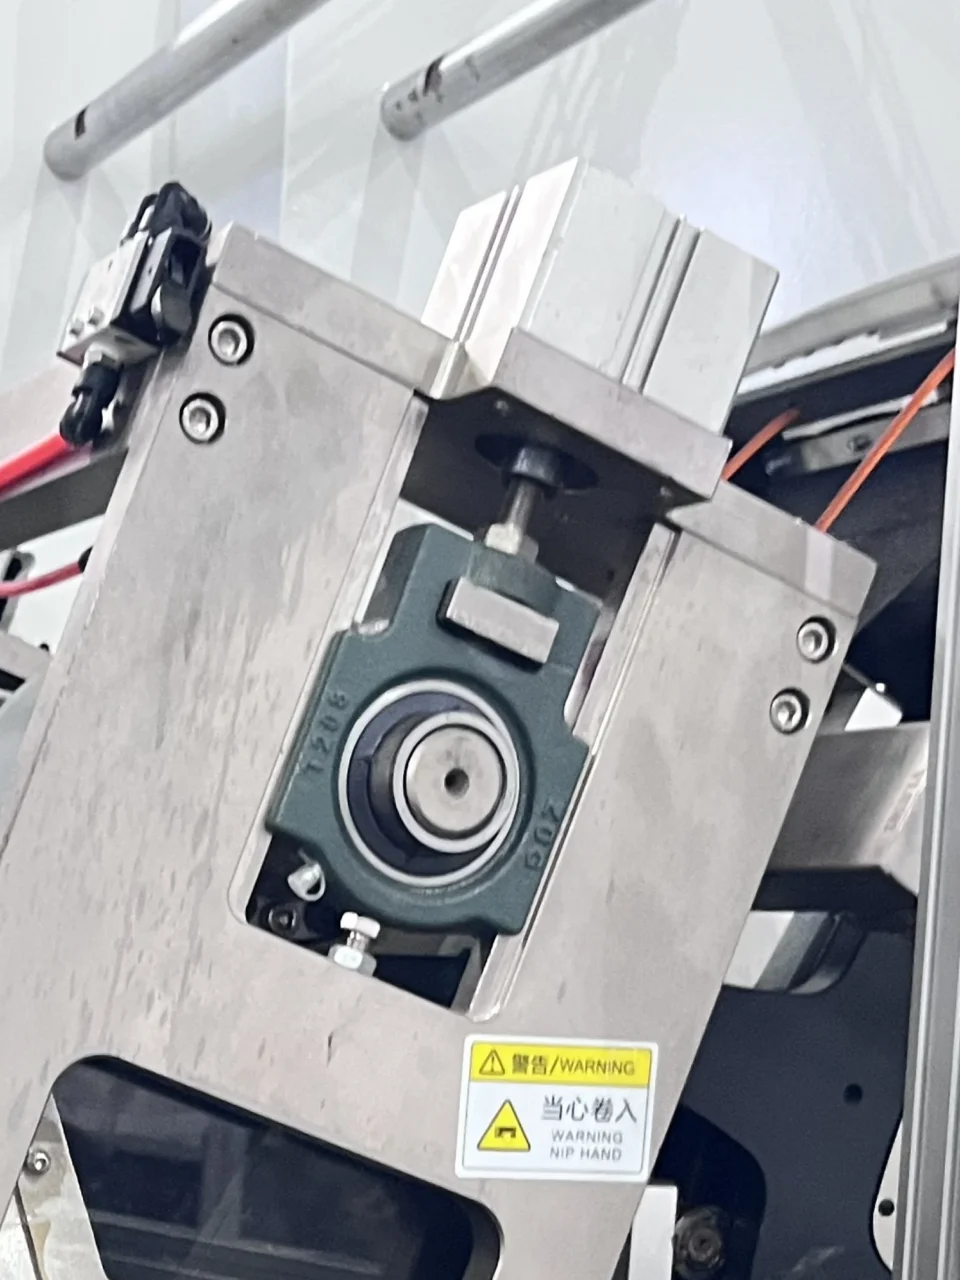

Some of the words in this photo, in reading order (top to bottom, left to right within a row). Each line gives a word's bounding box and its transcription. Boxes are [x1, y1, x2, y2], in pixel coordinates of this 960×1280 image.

[541, 1095, 638, 1124] 当心卷入
[551, 1130, 624, 1145] WARNING
[549, 1147, 575, 1160] NIP
[580, 1148, 623, 1162] HAND
